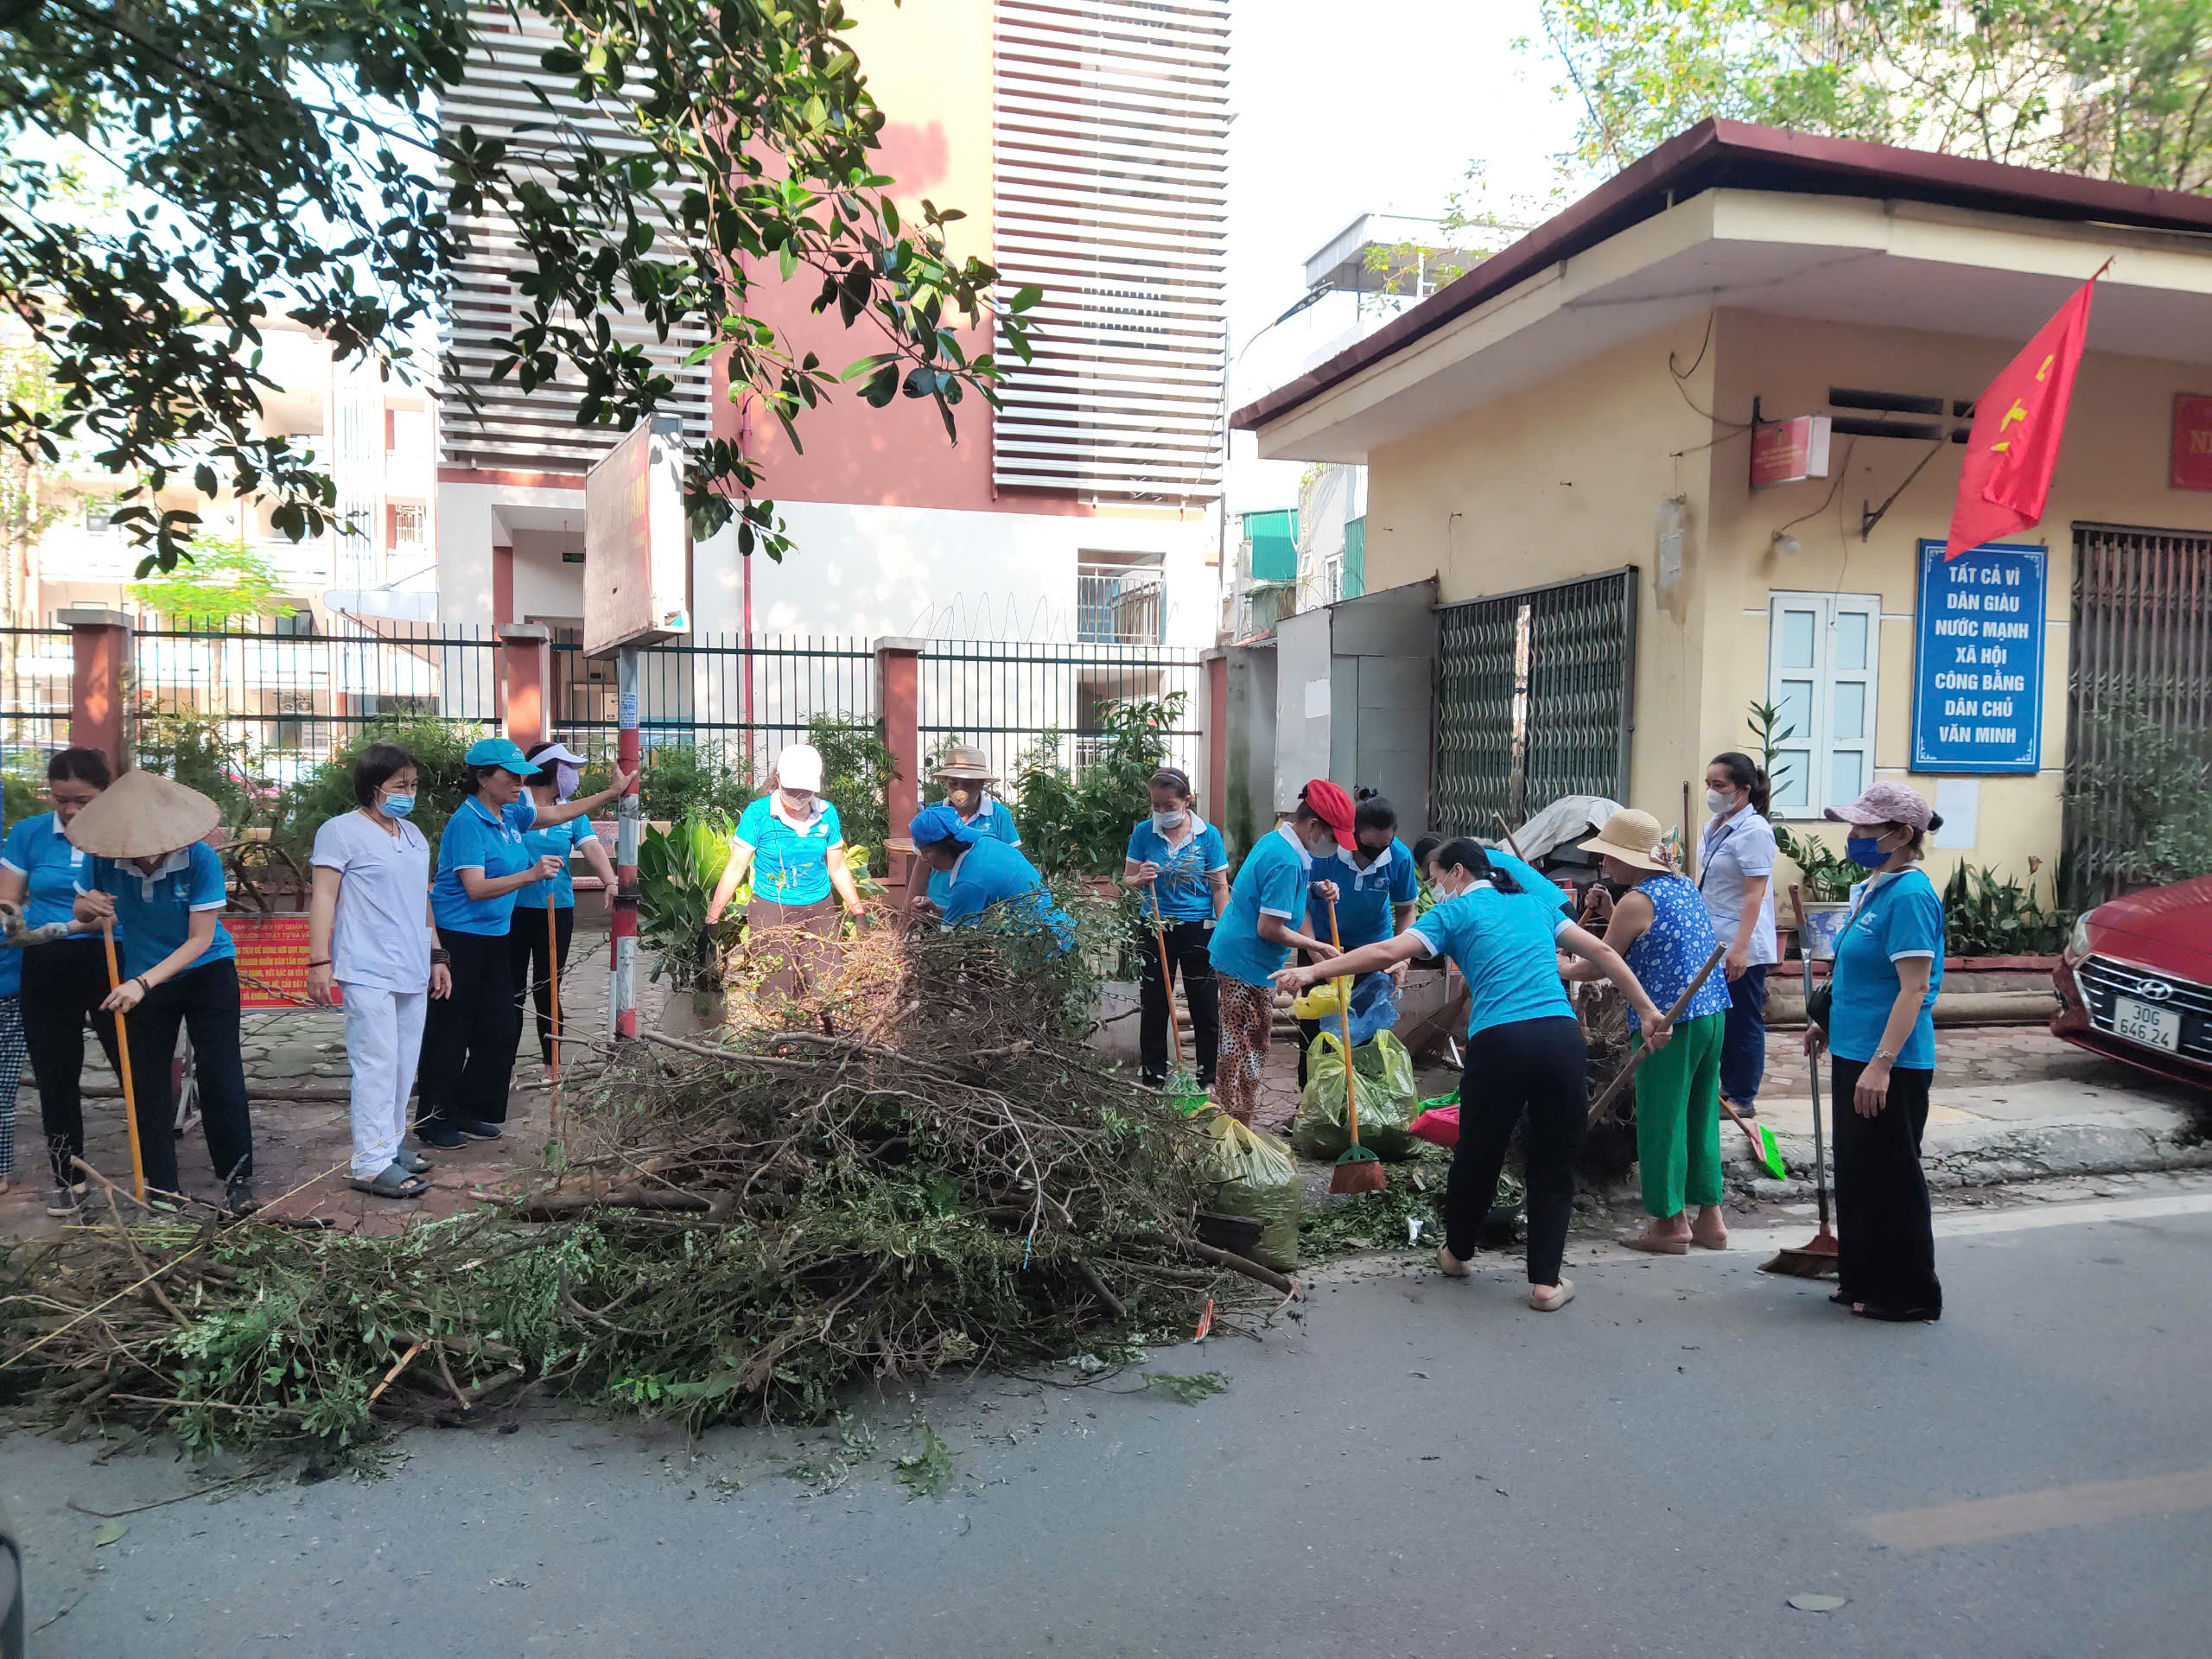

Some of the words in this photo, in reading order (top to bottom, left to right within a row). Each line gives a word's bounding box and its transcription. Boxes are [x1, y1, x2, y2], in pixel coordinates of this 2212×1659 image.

[1949, 562, 1977, 584] TẤT
[1980, 563, 2001, 585] CẢ
[2005, 566, 2020, 586] VÌ
[1947, 591, 1980, 610] DÂN
[1984, 593, 2020, 613] GIÀU
[1935, 617, 1979, 638] NƯỚC
[1983, 621, 2029, 642] MẠNH
[1955, 645, 1977, 664] XÃ
[1980, 647, 2007, 668] HỘI
[1935, 671, 1979, 690] CÔNG
[1982, 669, 2024, 691] BẰNG
[1944, 697, 1978, 716] DÂN
[1981, 696, 2013, 717] CHỦ
[1939, 724, 1972, 743] VĂN
[1974, 727, 2017, 744] MINH
[2133, 1005, 2161, 1026] 30G
[2120, 1019, 2170, 1047] 646.24
